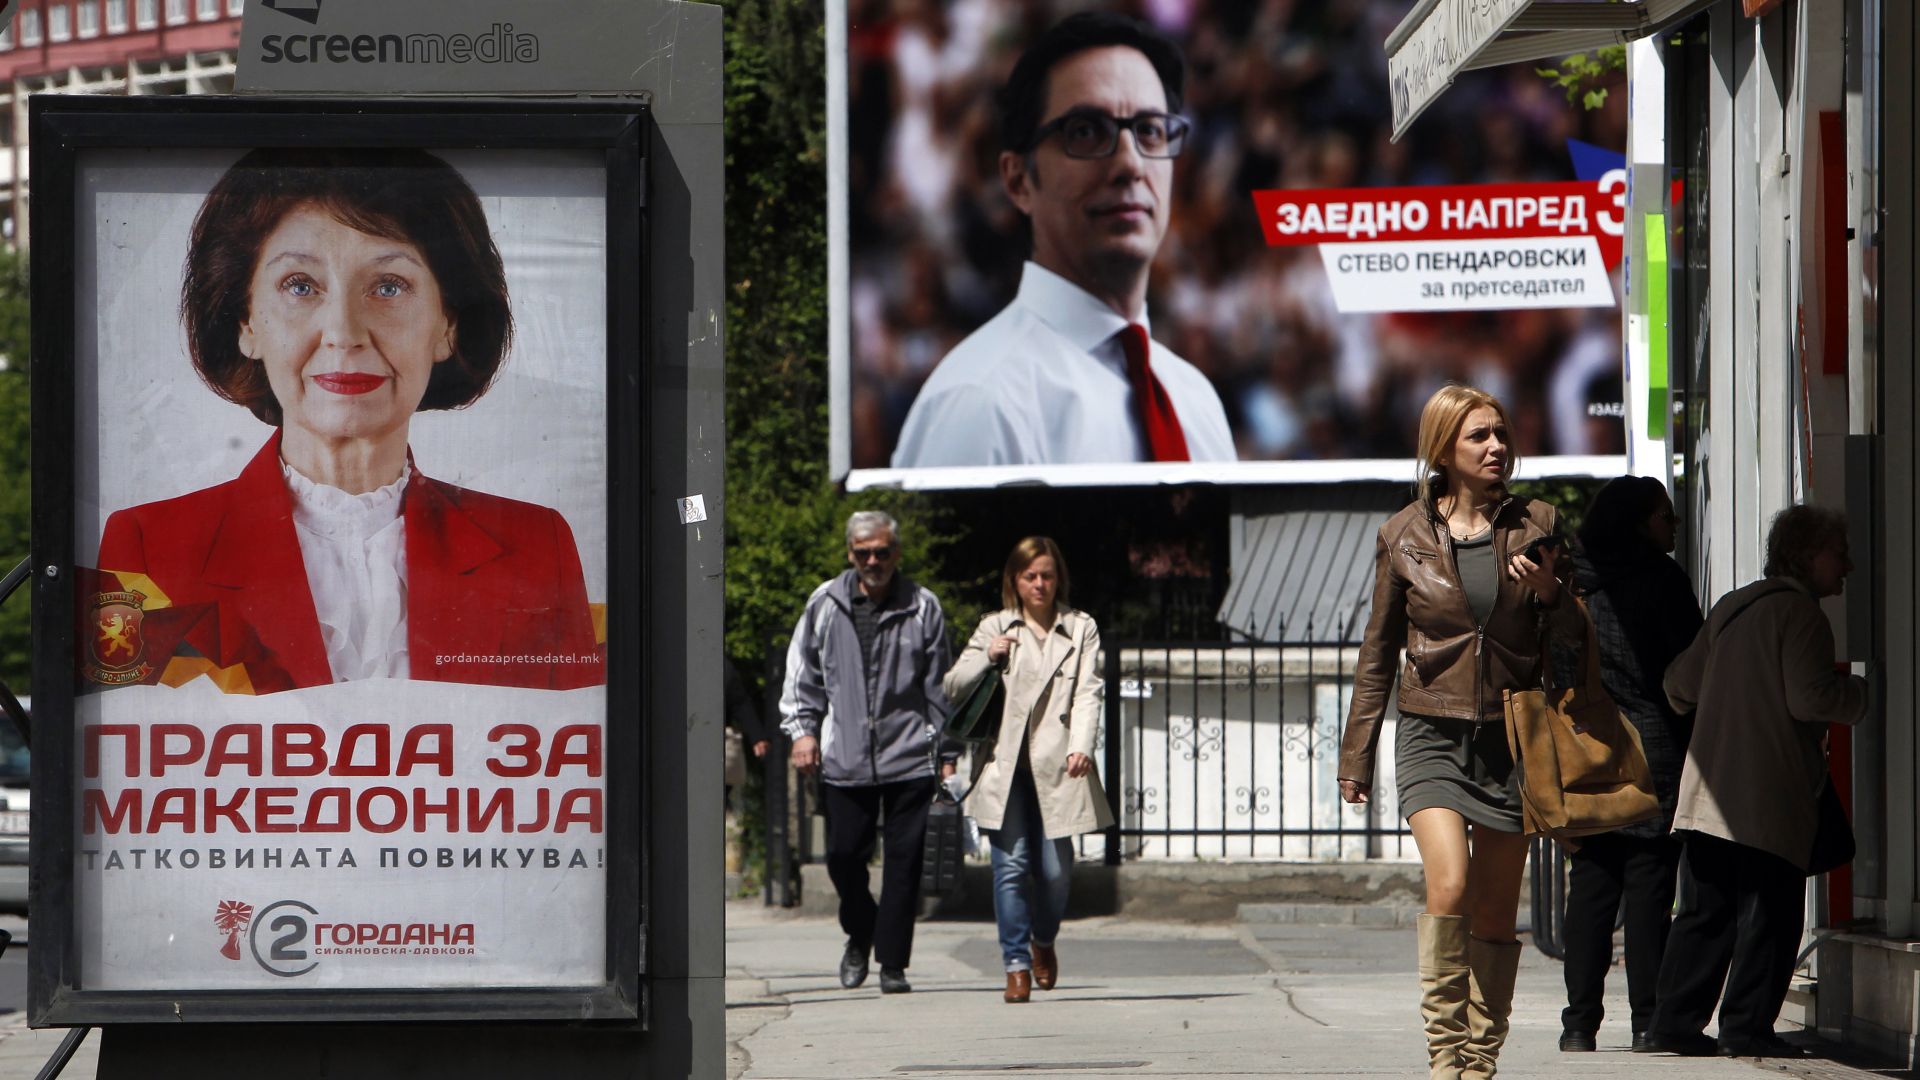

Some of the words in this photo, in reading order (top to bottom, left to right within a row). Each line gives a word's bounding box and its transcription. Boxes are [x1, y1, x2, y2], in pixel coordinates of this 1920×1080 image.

[261, 23, 539, 63] screenmedia
[1276, 201, 1429, 238] ЗАЕДНО
[1440, 195, 1588, 233] НАПРЕД
[1338, 252, 1409, 272] СТЕВО
[1415, 248, 1586, 274] ПЕНДАРОВСКИ
[1421, 283, 1446, 298] за
[1451, 278, 1585, 300] претседател
[435, 652, 600, 665] gordanazapretsedatel.mk
[83, 723, 454, 778] ПРАВДА
[486, 723, 602, 778] ЗА
[82, 786, 603, 835] МАКЕДОНИЈА
[82, 847, 358, 871] ТАТКОВИНАТА
[379, 847, 603, 869] ПОВИКУВА!
[270, 915, 308, 961] 2
[314, 923, 475, 946] ГОРДАНА
